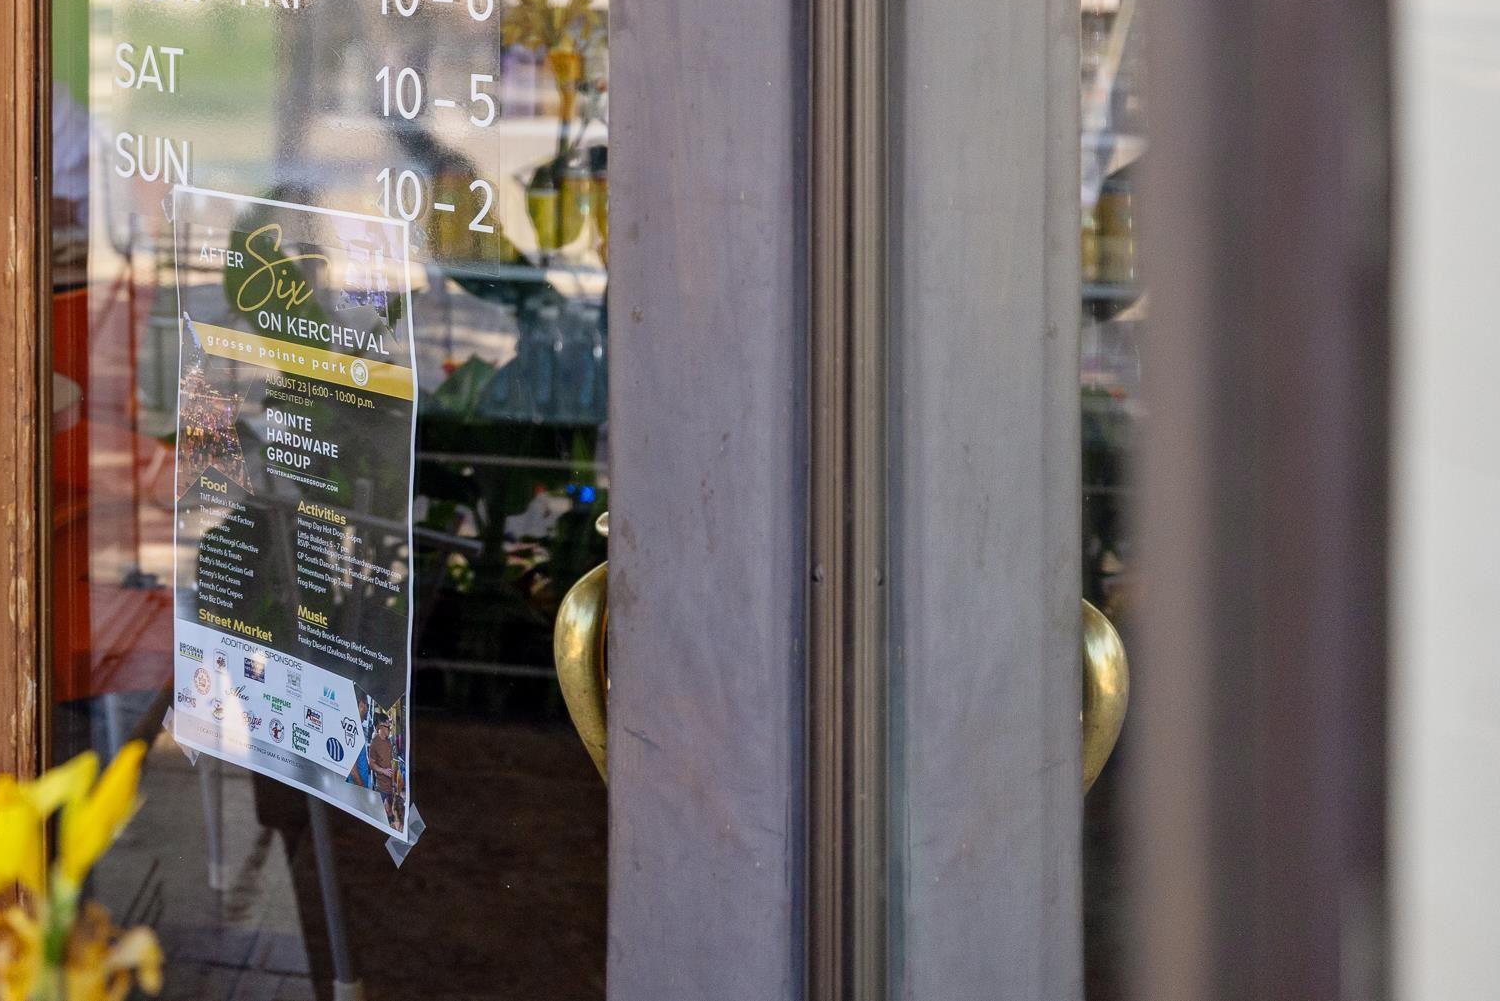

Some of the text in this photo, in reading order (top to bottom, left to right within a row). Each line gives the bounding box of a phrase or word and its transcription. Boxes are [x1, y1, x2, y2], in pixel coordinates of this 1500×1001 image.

[115, 42, 184, 94] SAT
[375, 66, 422, 120] 10
[469, 73, 496, 128] 5
[115, 132, 189, 187] SUN
[375, 167, 422, 222] 10
[468, 179, 495, 234] 2
[199, 223, 331, 312] AFTER Six
[258, 310, 390, 356] ON KERCHEVAL
[206, 335, 347, 375] grosse pointe park
[266, 408, 312, 432] POINTE
[266, 427, 339, 459] HARDWARE
[266, 447, 311, 470] GROUP
[200, 476, 227, 494] Food
[297, 500, 347, 525] Activities
[198, 608, 273, 642] Street Market
[297, 605, 328, 626] Music
